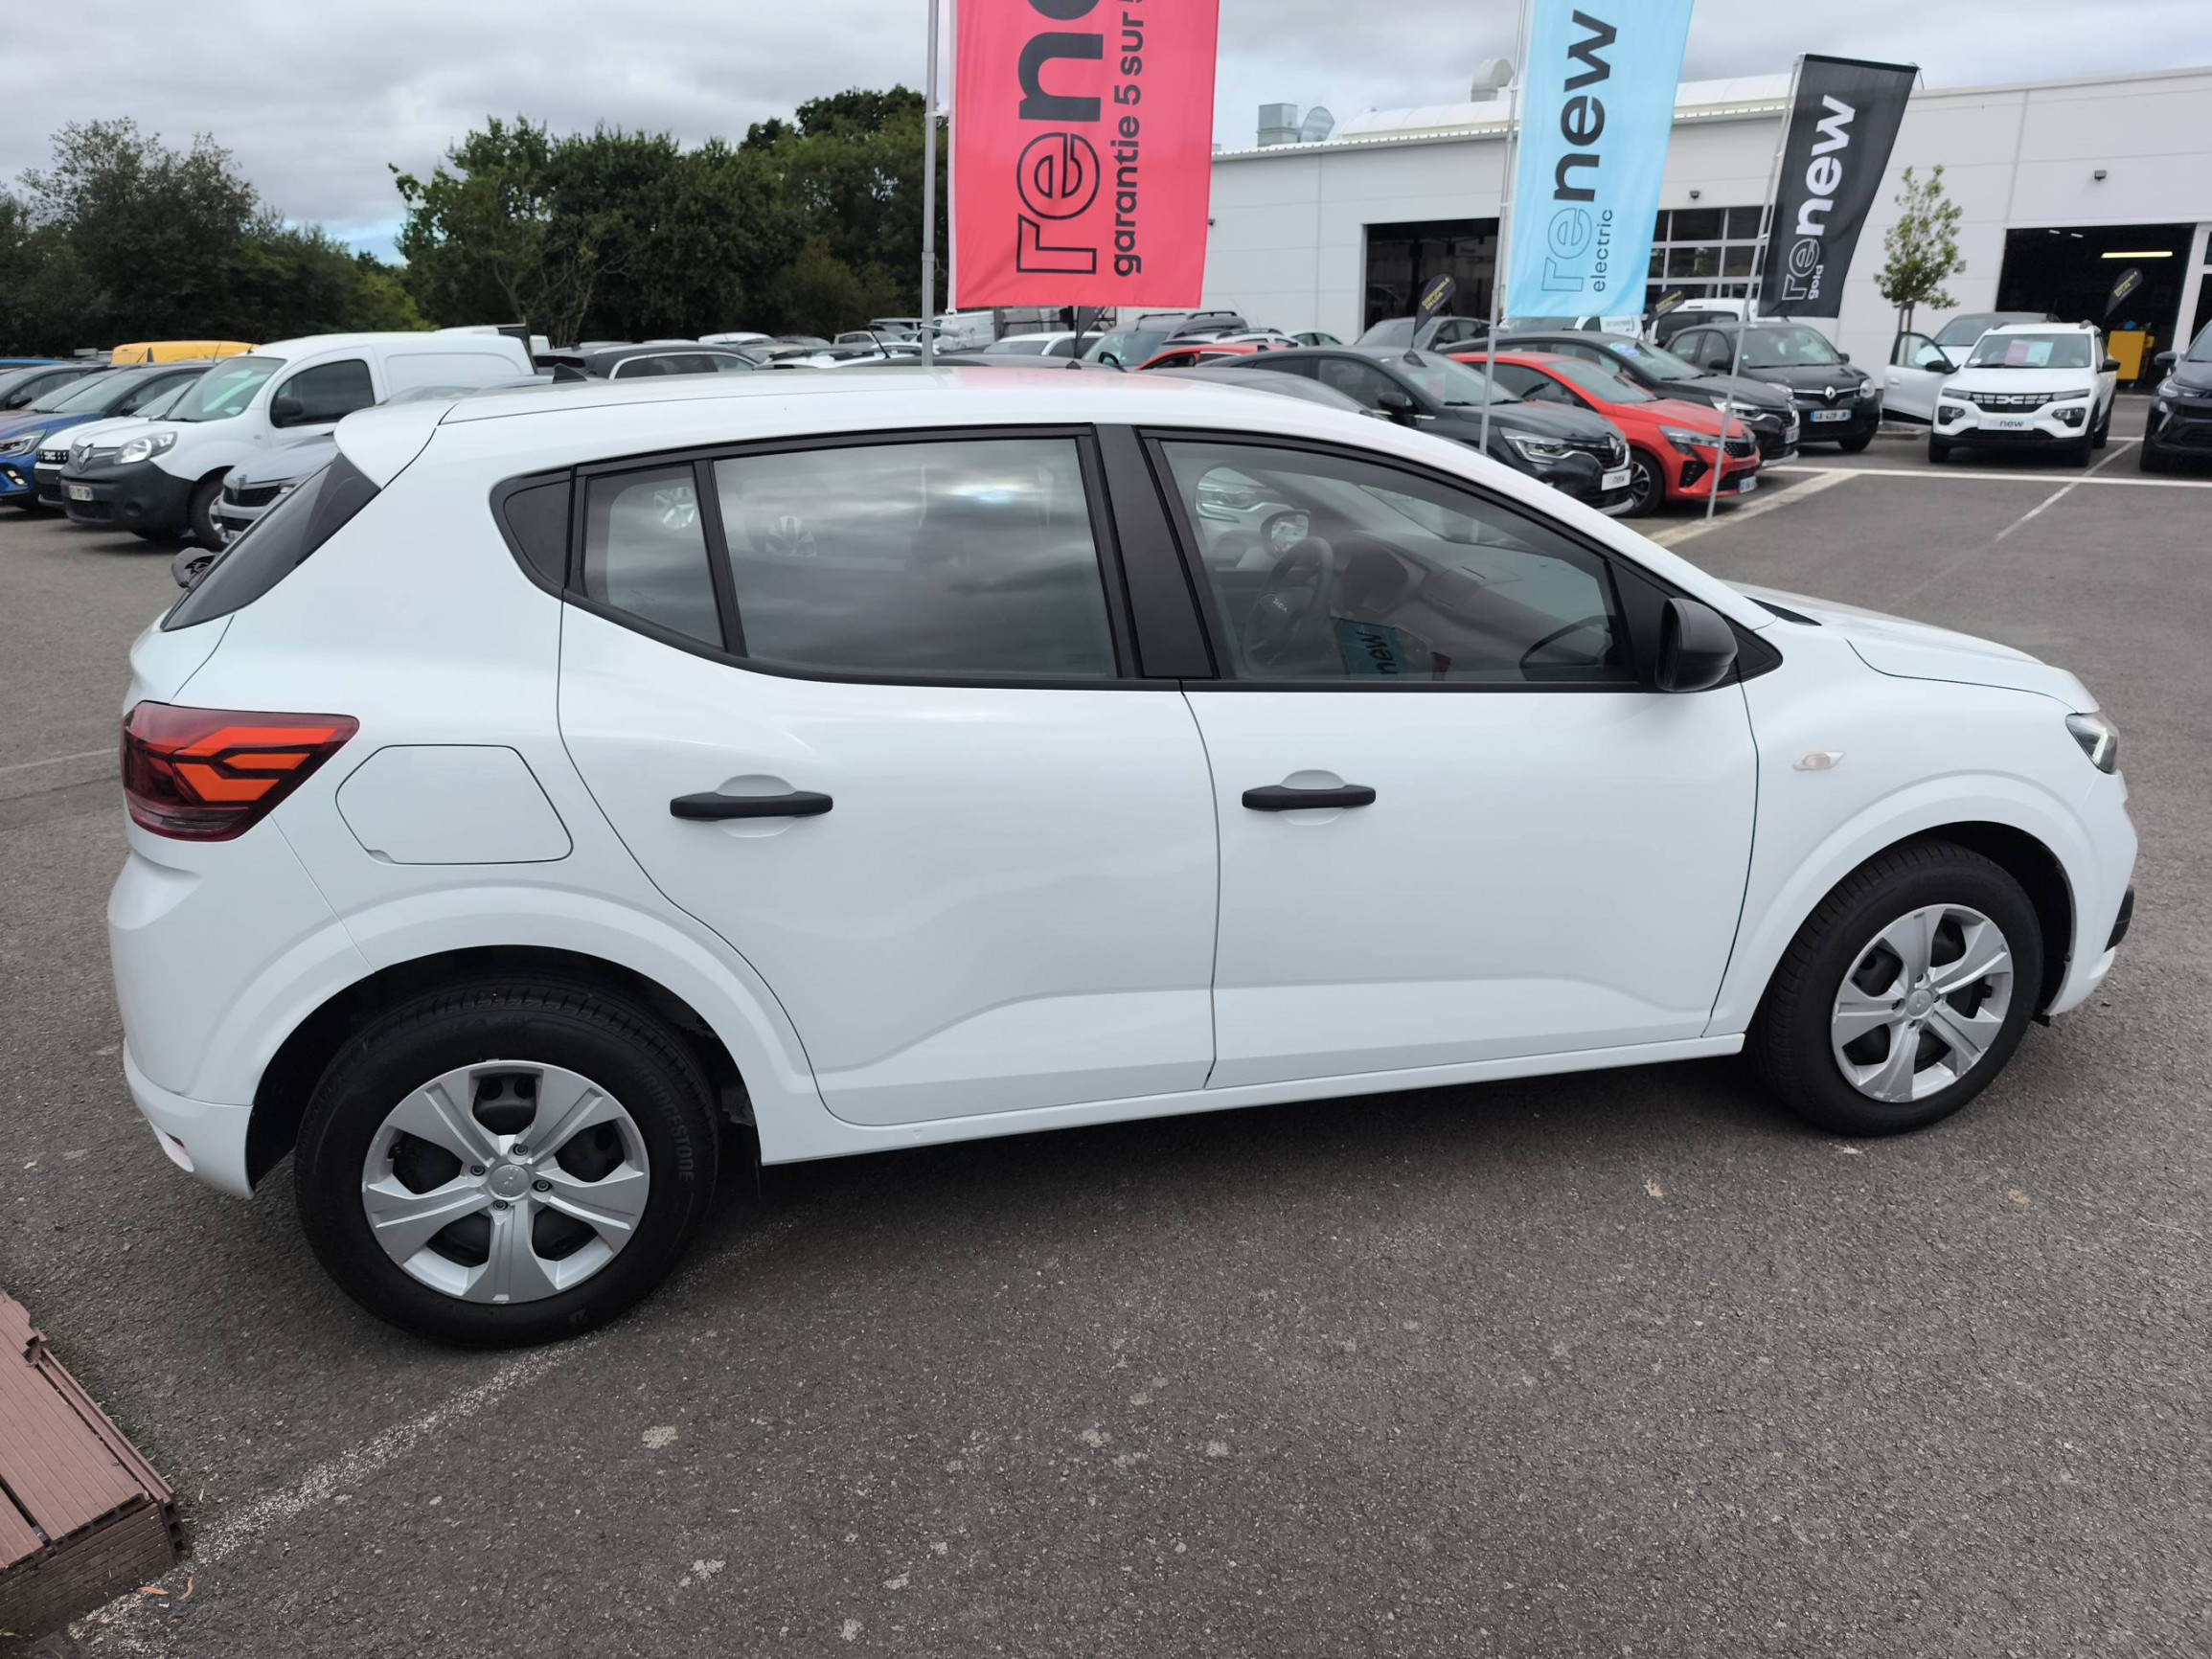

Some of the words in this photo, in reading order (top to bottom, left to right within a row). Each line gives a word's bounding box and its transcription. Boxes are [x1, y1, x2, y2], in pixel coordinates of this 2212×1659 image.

[1120, 11, 1144, 77] sur
[1113, 84, 1142, 105] 5
[1016, 0, 1104, 275] ren
[1540, 9, 1617, 292] renew
[1110, 116, 1143, 277] garantie
[1782, 94, 1856, 301] renew
[1590, 209, 1613, 292] electric
[1808, 264, 1824, 300] gold
[1356, 631, 1399, 674] new
